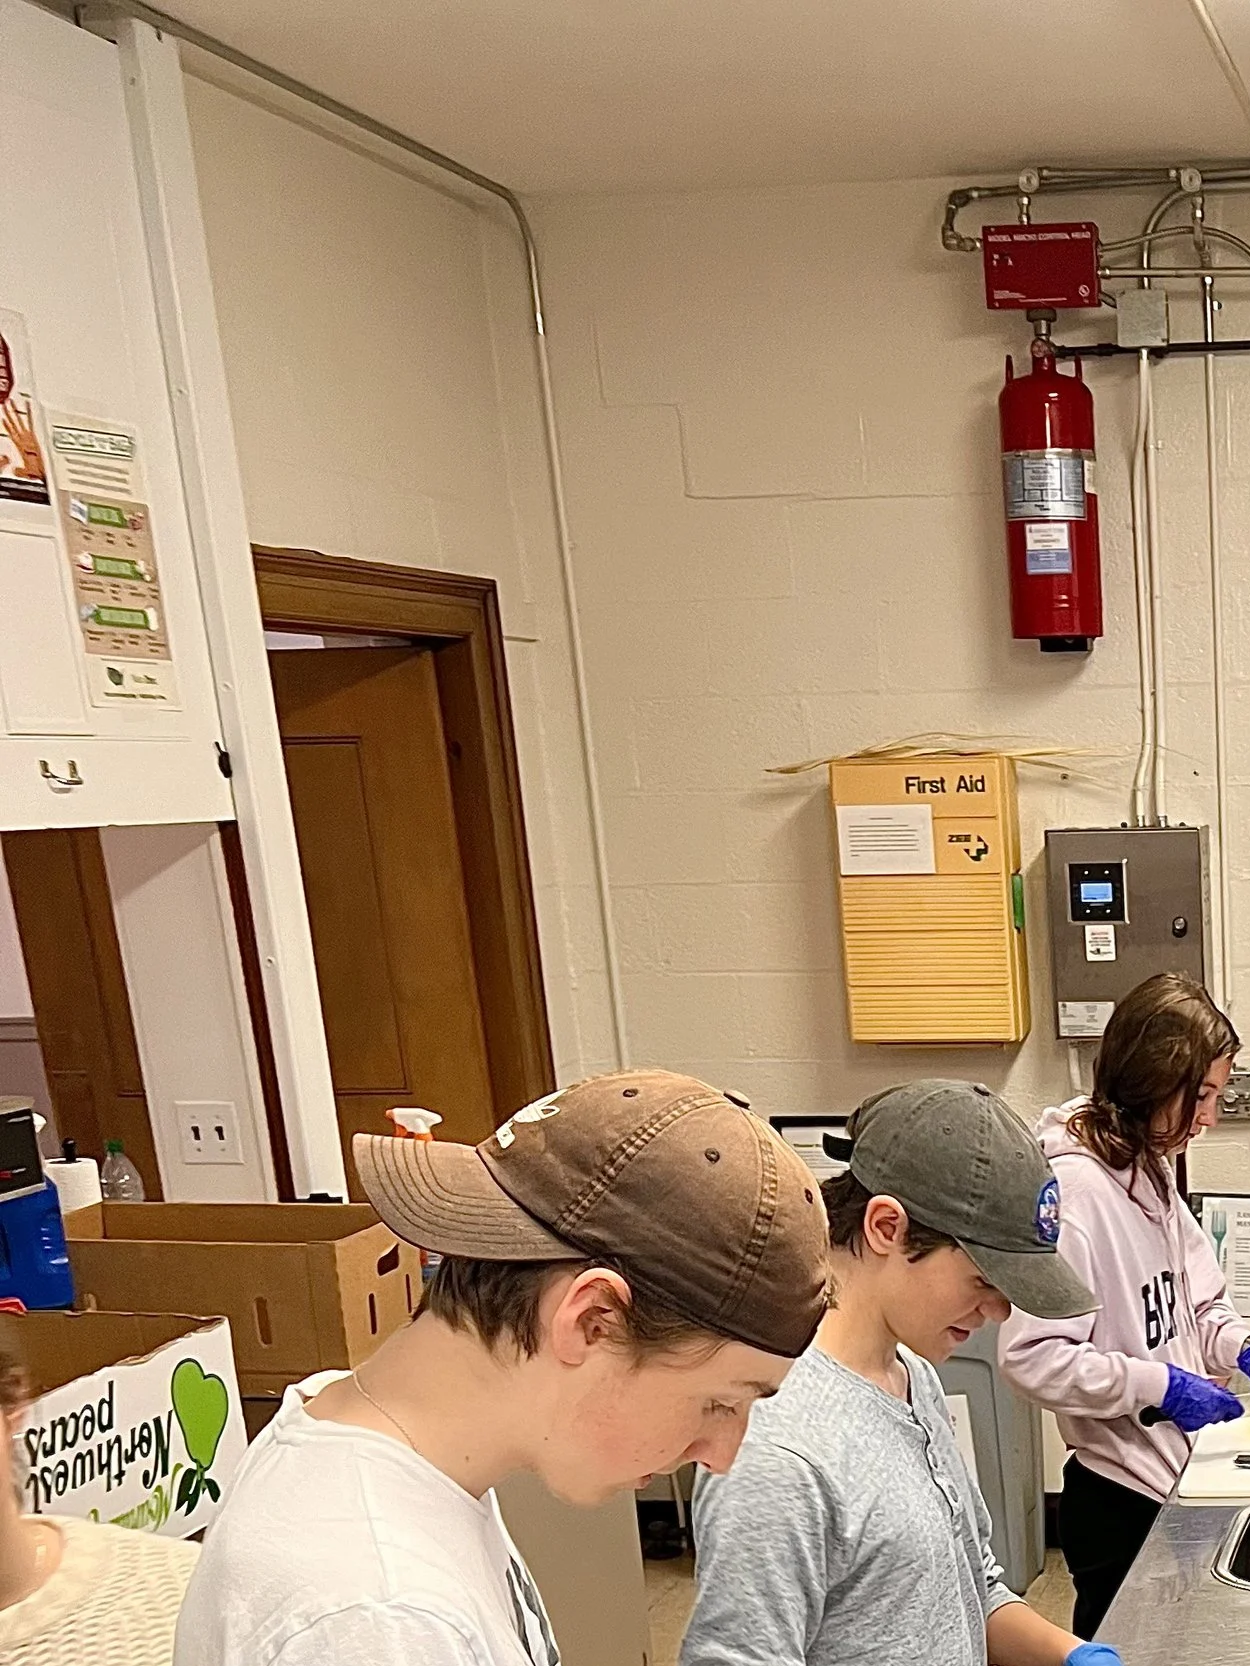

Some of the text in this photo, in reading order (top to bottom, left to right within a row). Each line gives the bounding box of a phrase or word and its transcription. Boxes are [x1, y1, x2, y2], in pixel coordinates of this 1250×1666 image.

[905, 775, 985, 794] First Aid
[25, 1380, 114, 1467] pears
[25, 1409, 173, 1513] Northwest
